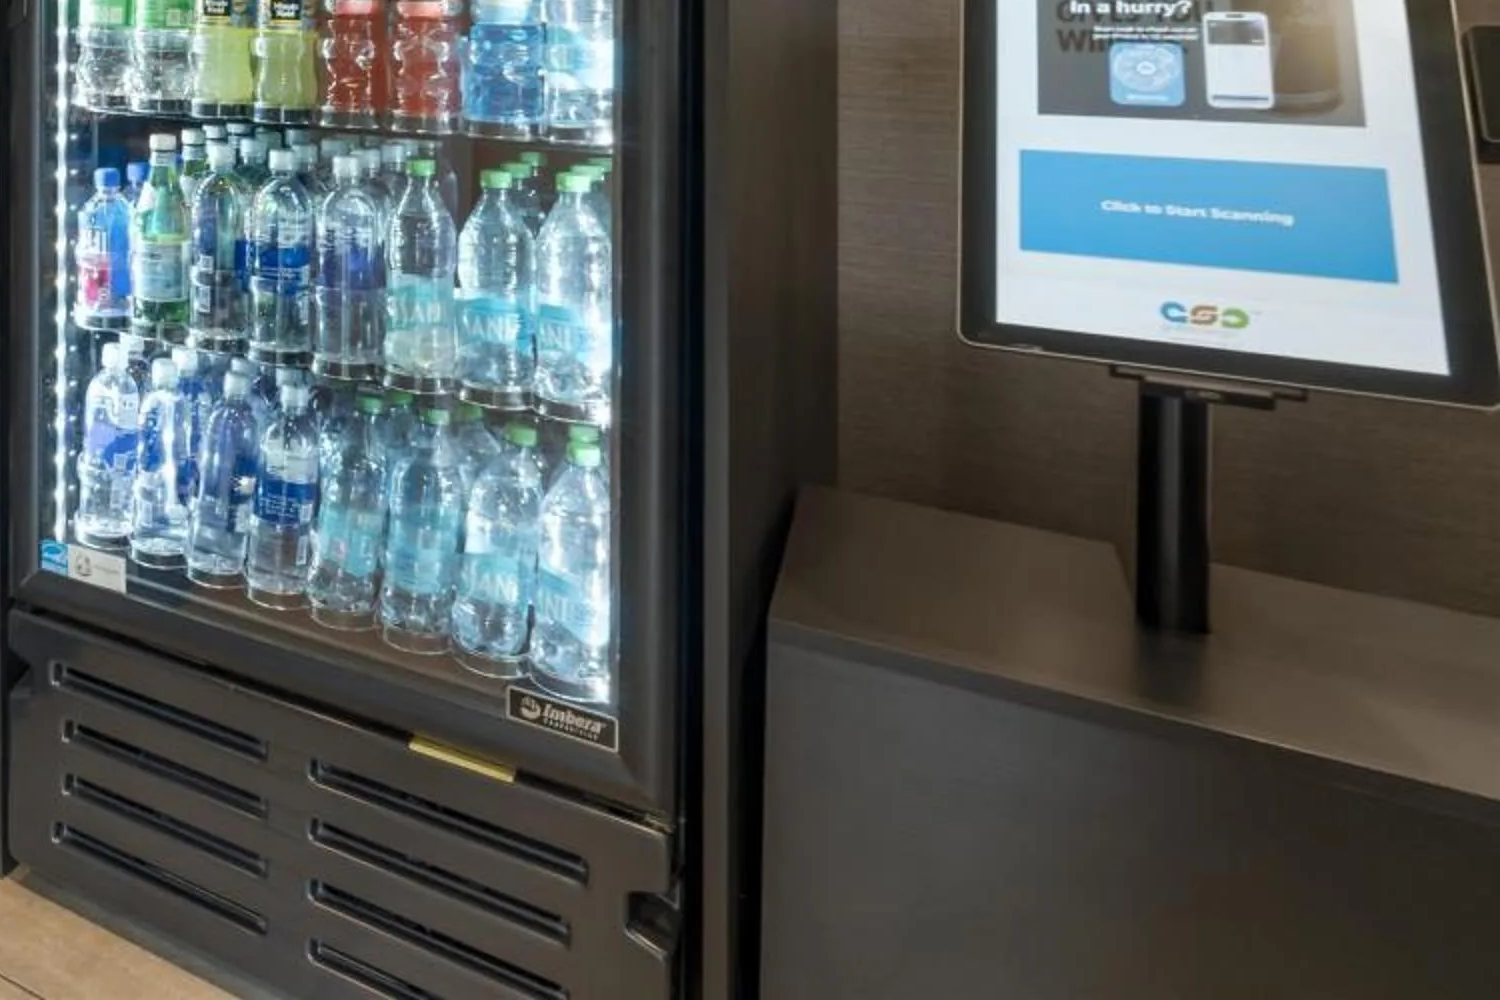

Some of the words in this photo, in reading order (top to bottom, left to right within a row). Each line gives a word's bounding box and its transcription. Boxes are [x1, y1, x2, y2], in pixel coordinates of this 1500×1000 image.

[1069, 0, 1091, 14] In
[1100, 199, 1142, 213] Click
[1144, 203, 1163, 215] to
[1165, 205, 1208, 219] Start
[1210, 207, 1295, 227] Scanning
